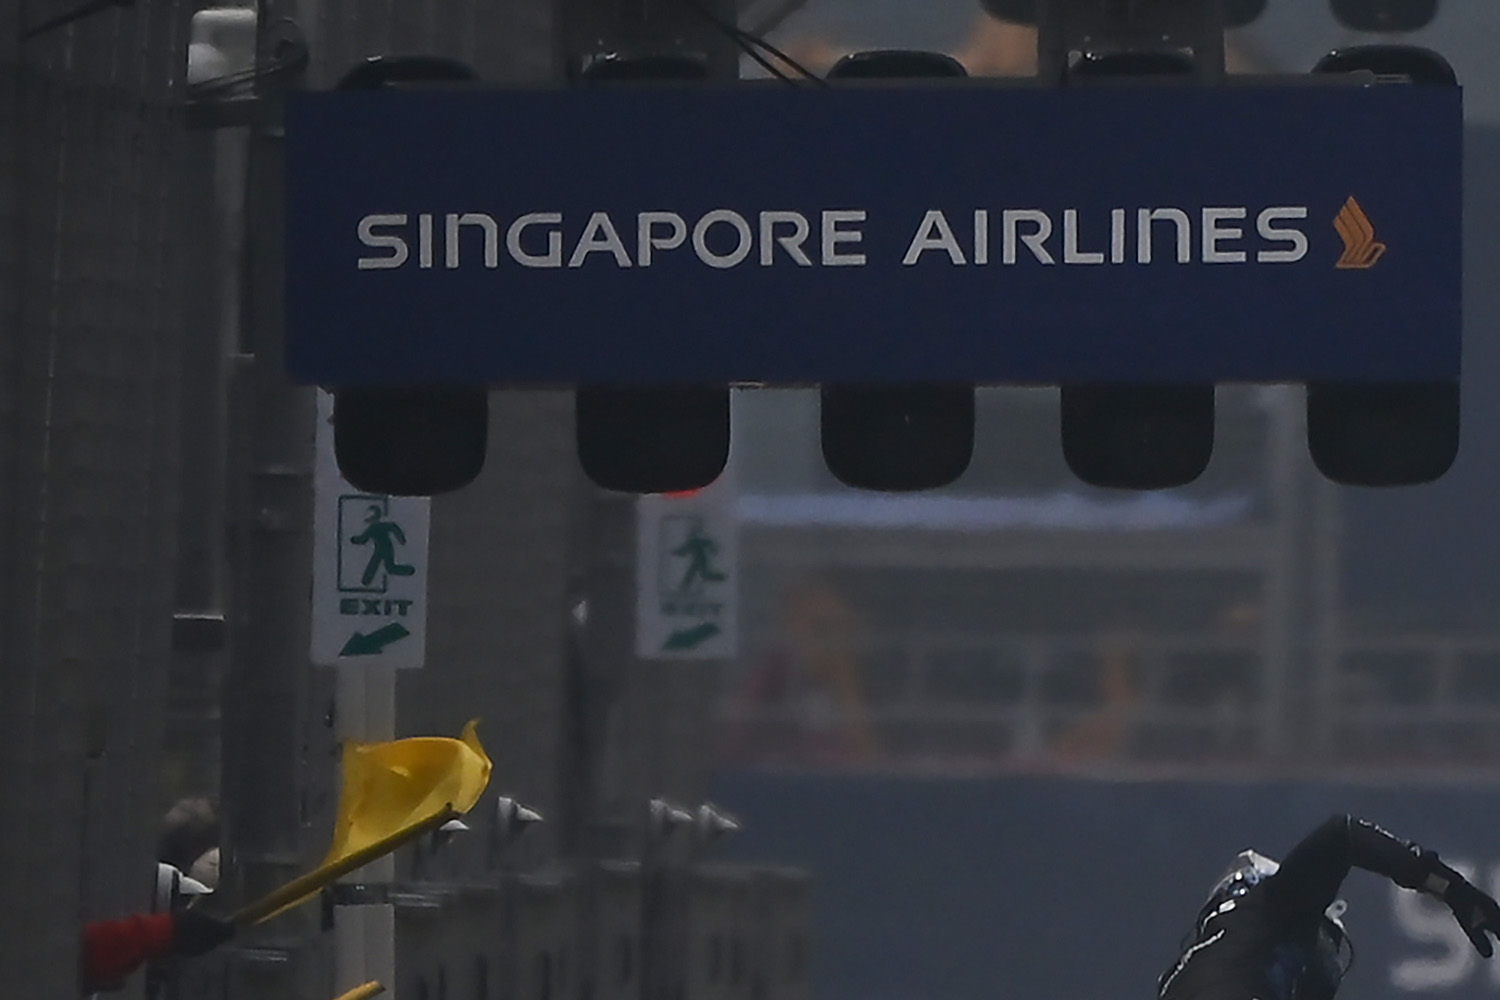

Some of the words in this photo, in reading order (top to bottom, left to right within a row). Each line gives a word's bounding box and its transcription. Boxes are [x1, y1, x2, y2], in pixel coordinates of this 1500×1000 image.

[357, 208, 867, 270] SINGAPORE
[902, 205, 1309, 266] AIRLINES
[340, 598, 413, 616] EXIT
